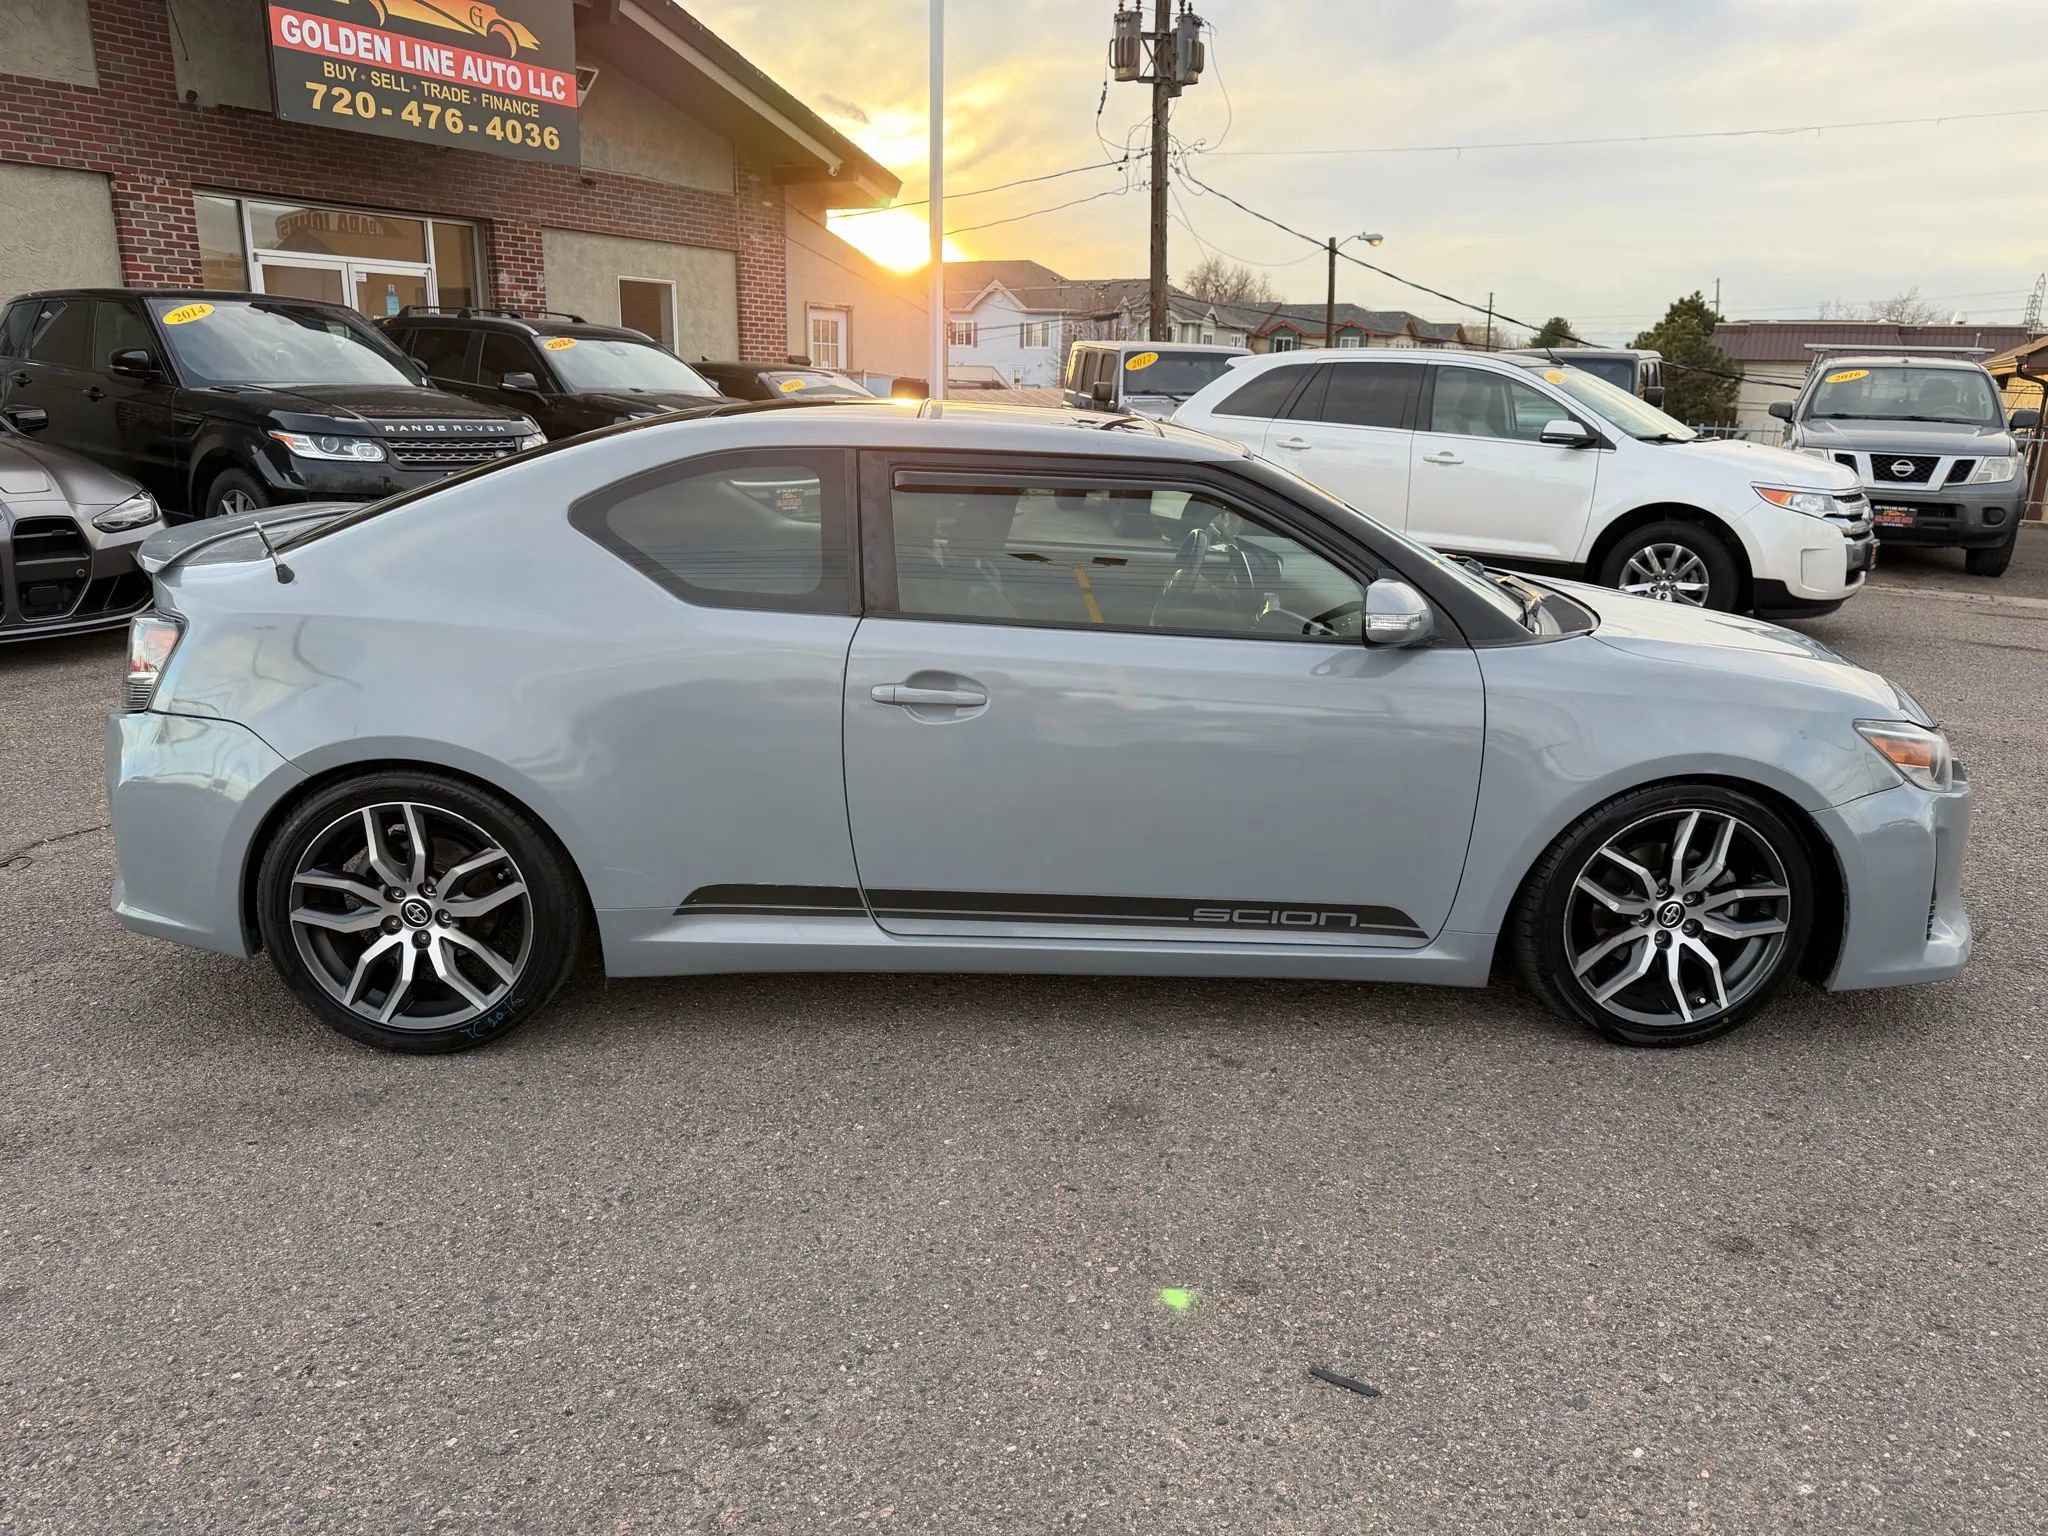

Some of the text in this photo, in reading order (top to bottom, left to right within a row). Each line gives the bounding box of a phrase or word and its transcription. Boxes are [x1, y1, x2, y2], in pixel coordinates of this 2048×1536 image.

[280, 14, 566, 101] GOLDEN LINE AUTO LLC
[323, 61, 540, 118] BUY SELL TRADE FINANCE
[304, 81, 561, 151] 720-476-4036
[173, 305, 206, 322] 2014
[1132, 353, 1152, 368] 2017
[1834, 371, 1861, 381] 2016
[384, 424, 447, 432] RANGE
[1193, 908, 1358, 927] SCION
